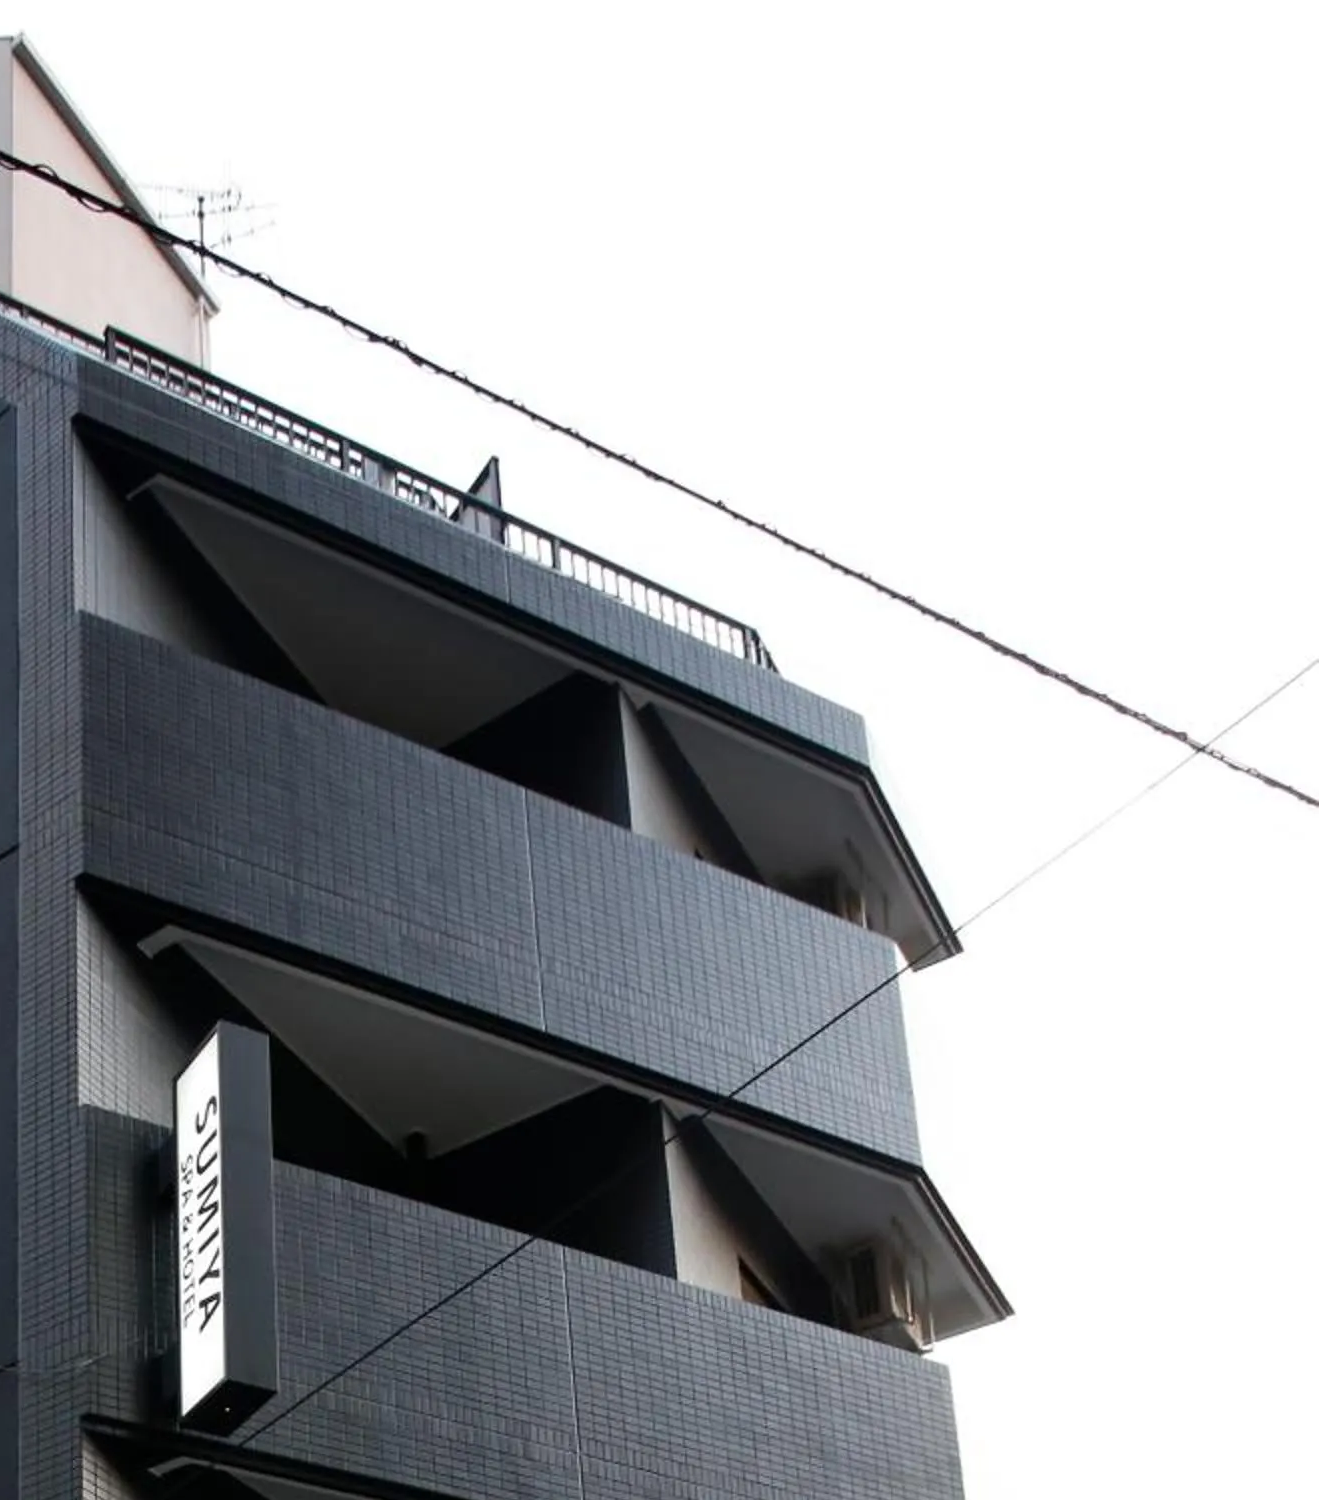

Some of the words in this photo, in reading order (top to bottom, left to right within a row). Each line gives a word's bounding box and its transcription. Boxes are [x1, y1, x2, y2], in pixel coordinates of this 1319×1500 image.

[180, 1154, 194, 1210] SPA
[196, 1095, 222, 1334] SUMIYA
[182, 1237, 195, 1329] HOTEL
